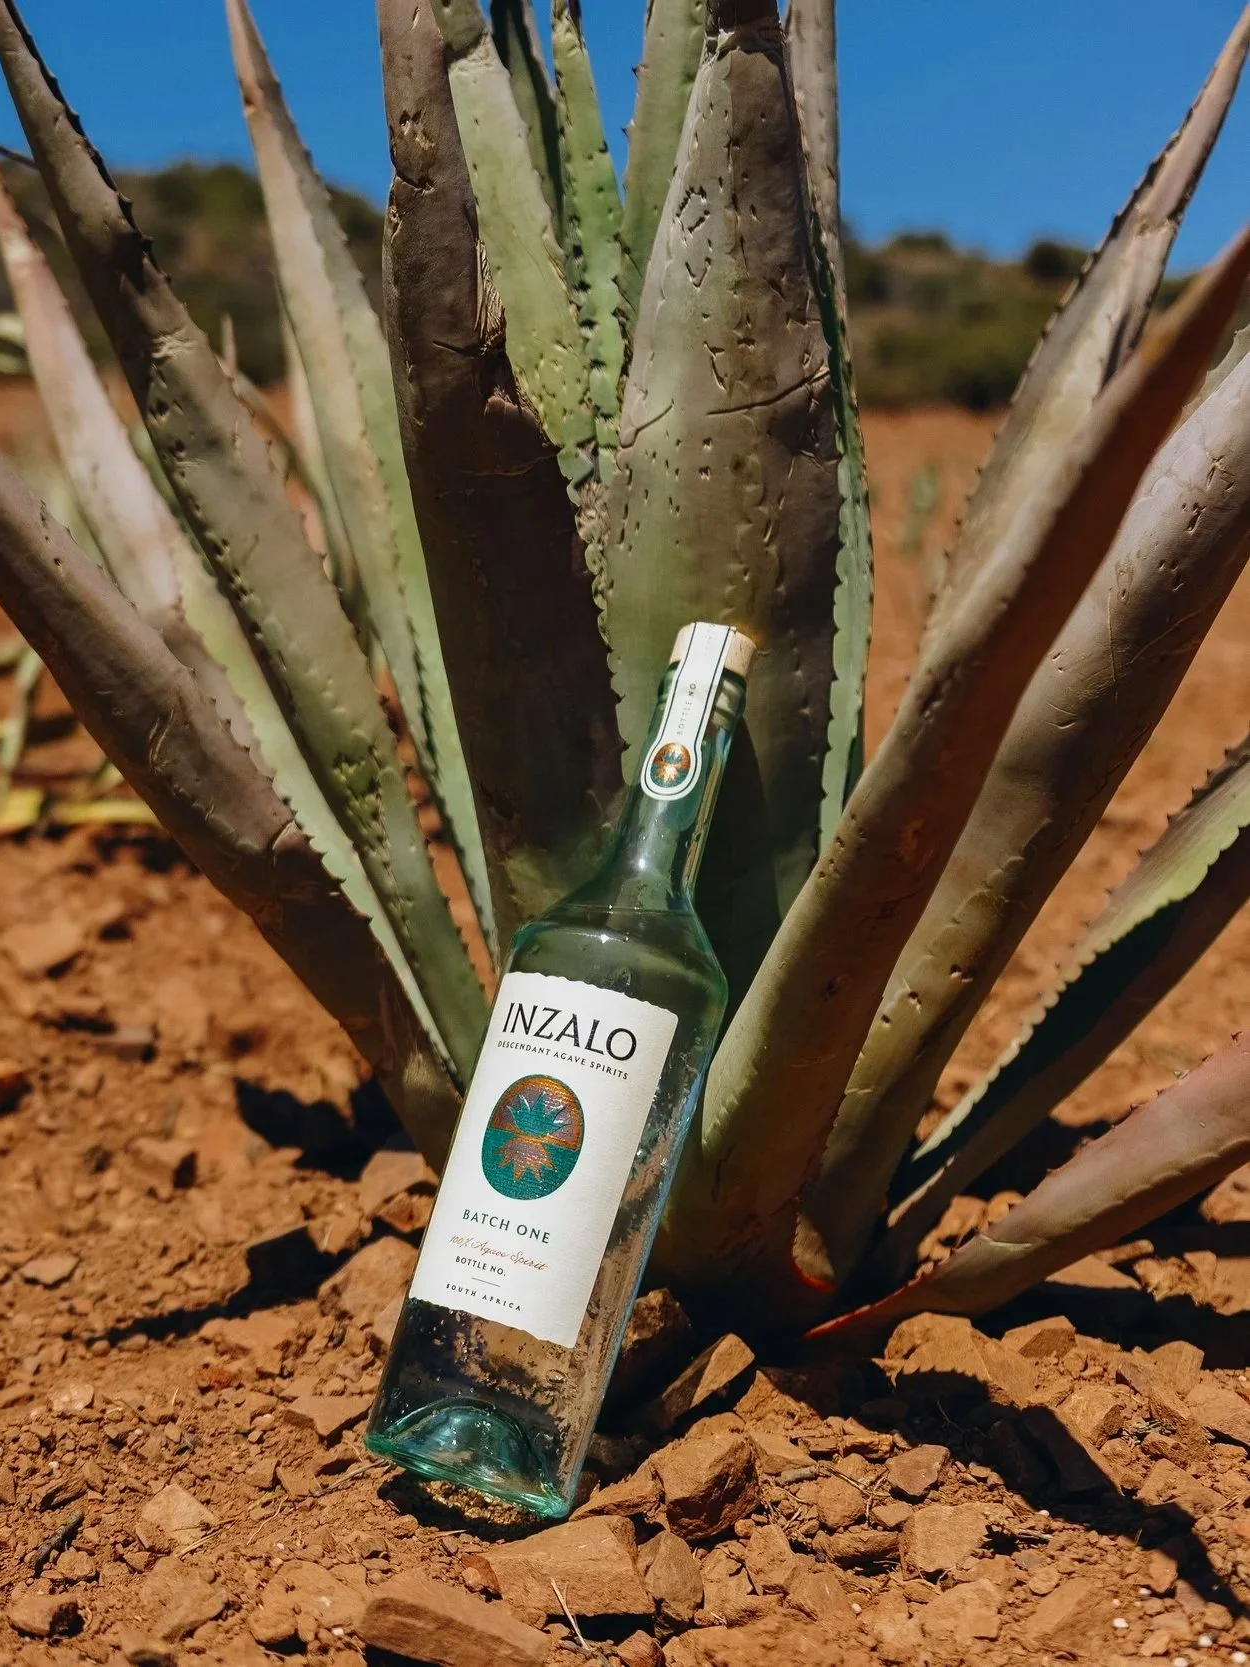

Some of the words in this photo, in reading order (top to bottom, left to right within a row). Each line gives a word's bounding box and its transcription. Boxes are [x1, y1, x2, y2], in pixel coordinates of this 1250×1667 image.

[676, 701, 692, 736] BOTTLE
[689, 683, 697, 698] NO
[502, 1002, 637, 1061] INZALO
[497, 1040, 551, 1056] DESCENDANT
[553, 1051, 586, 1066] AGAVE
[589, 1061, 629, 1080] SPIRITS
[462, 1209, 510, 1231] BATCH
[516, 1224, 551, 1244] ONE
[455, 1255, 487, 1270] BOTTLE
[489, 1265, 506, 1277] NO.
[470, 1241, 510, 1258] Agave
[510, 1251, 549, 1271] Spirit
[445, 1283, 477, 1297] SOUTH
[482, 1294, 521, 1311] AFRICA
